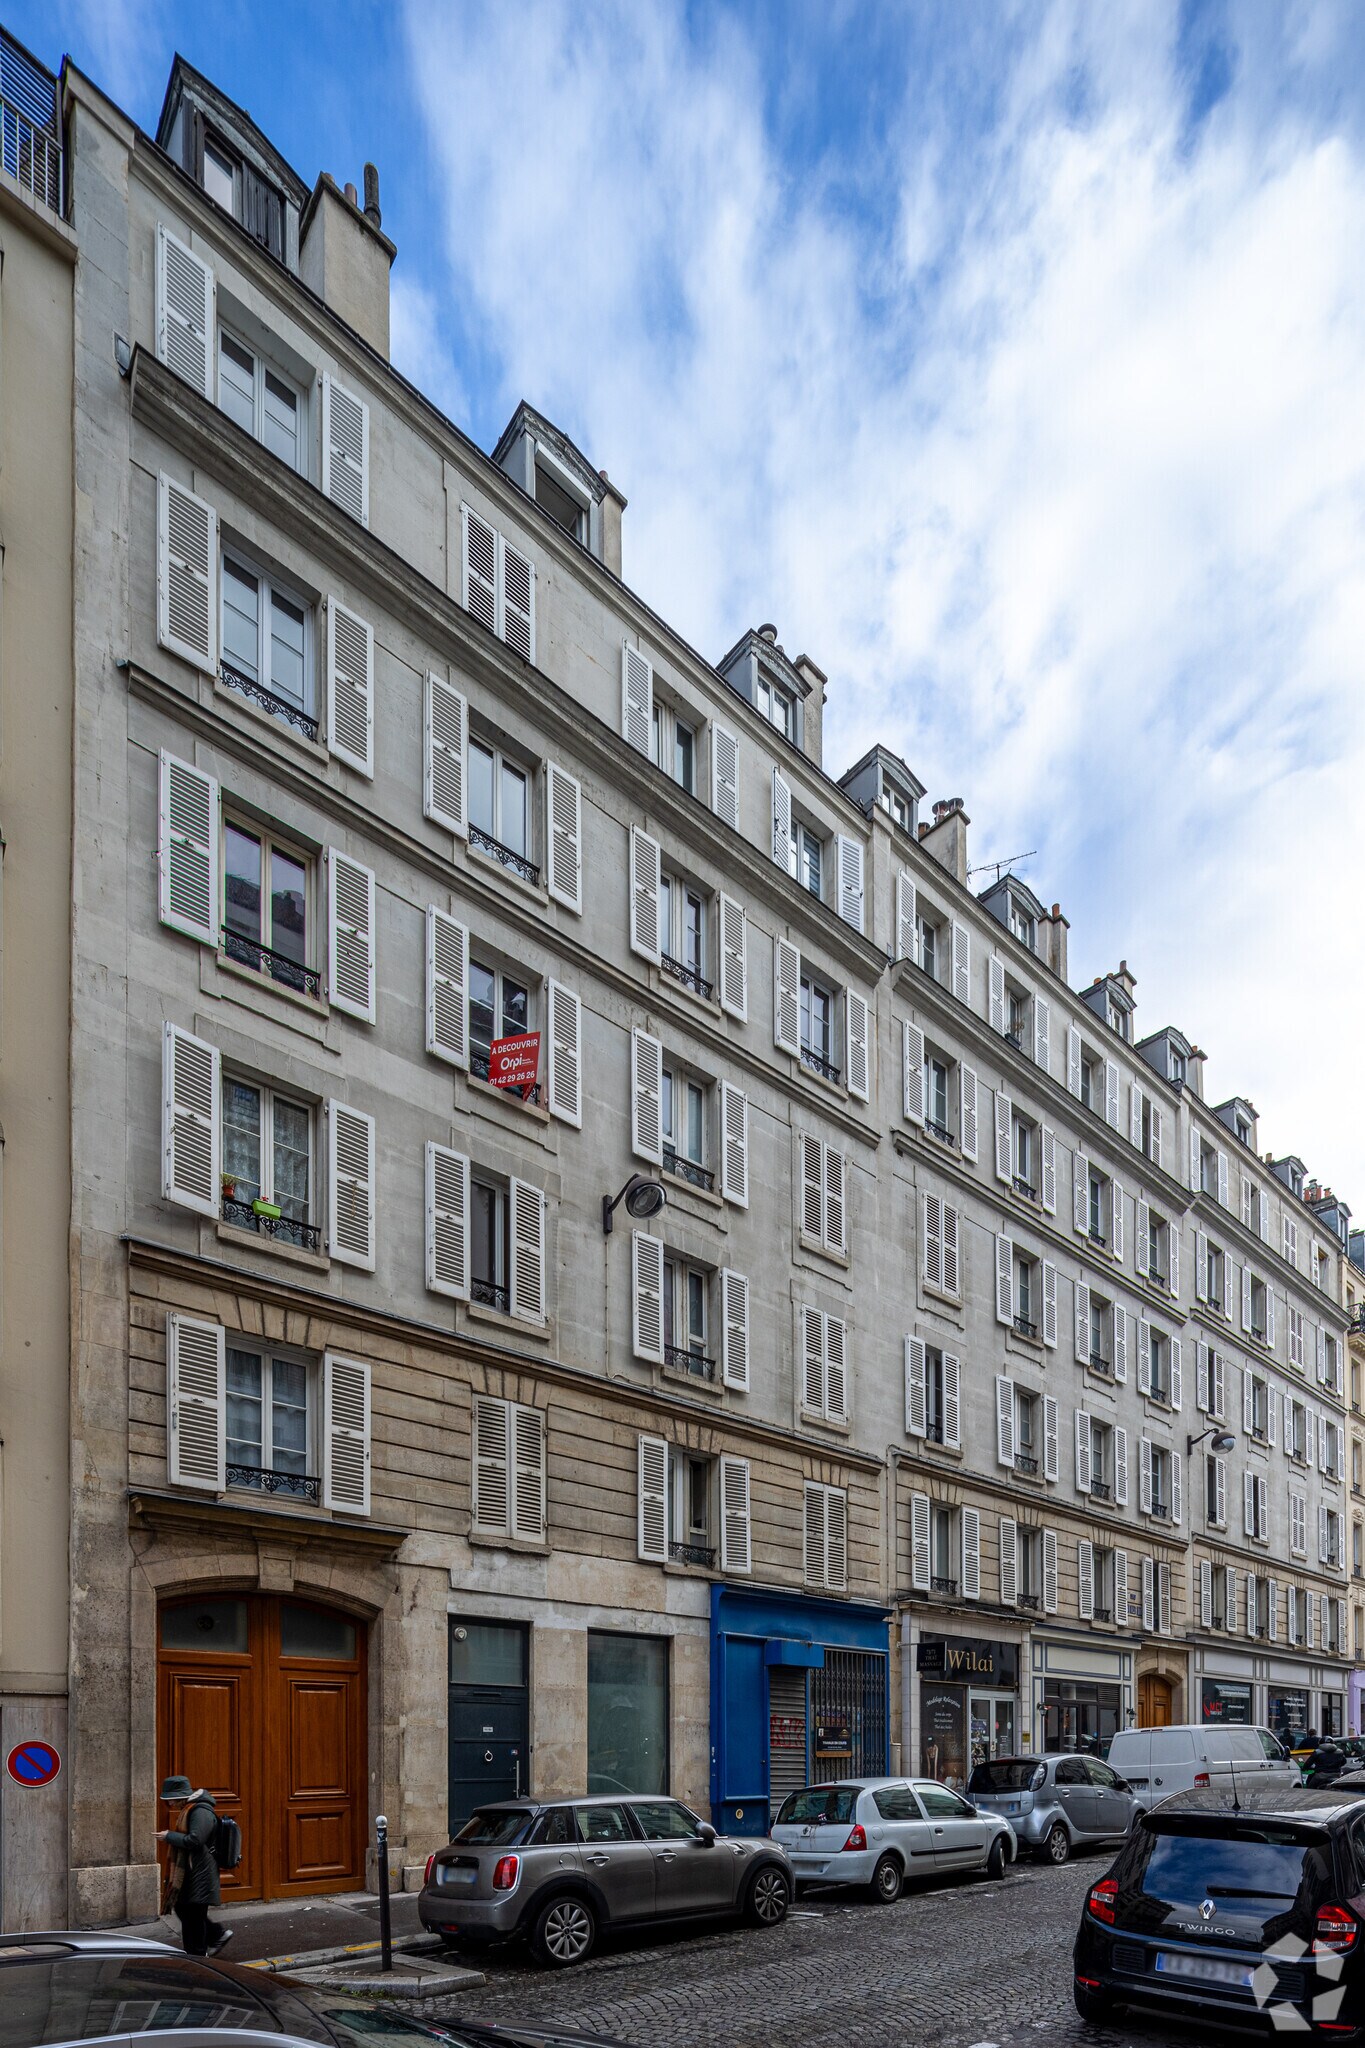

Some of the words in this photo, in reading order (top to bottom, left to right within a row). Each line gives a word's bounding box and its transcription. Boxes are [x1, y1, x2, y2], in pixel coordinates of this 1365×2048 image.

[491, 1047, 497, 1055] A
[498, 1039, 538, 1053] DECOUVRIR
[501, 1053, 522, 1070] Orpi
[498, 1076, 506, 1084] 42
[507, 1074, 516, 1083] 29
[516, 1073, 525, 1081] 26
[526, 1071, 535, 1079] 26
[948, 1649, 994, 1672] Wilai
[1176, 1922, 1236, 1936] TWINGO
